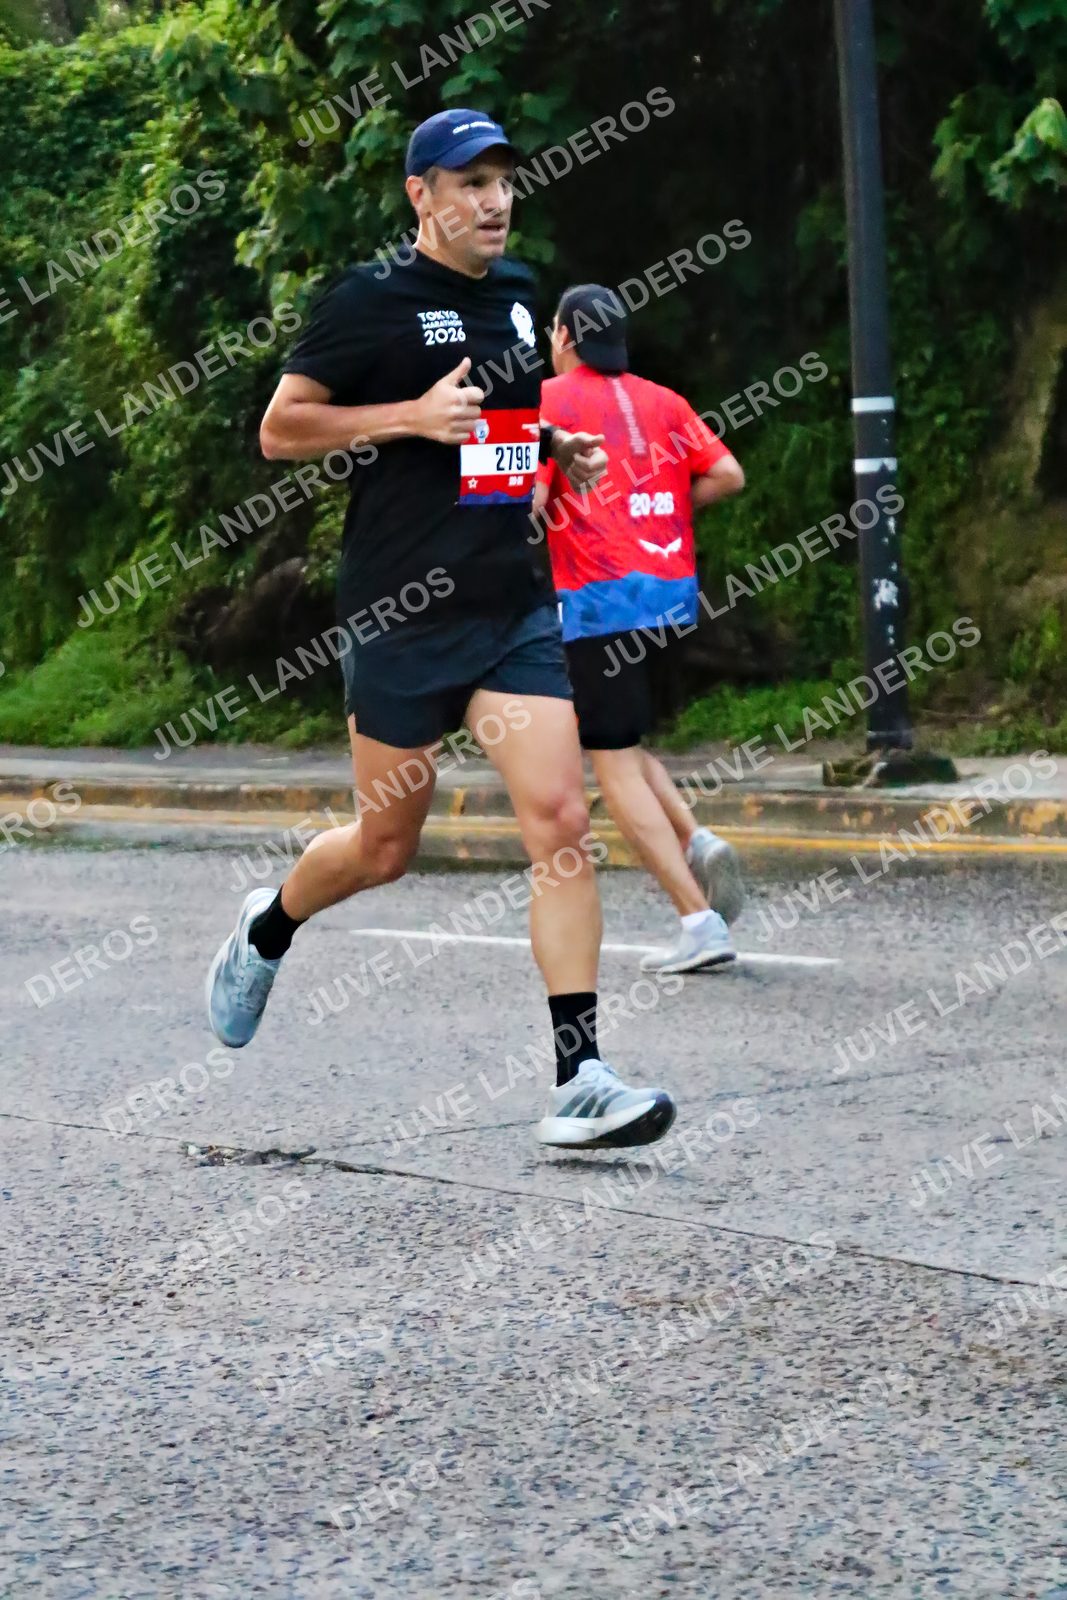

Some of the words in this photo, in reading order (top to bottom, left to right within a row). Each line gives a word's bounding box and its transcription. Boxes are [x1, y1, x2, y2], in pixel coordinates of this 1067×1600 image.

[417, 310, 459, 322] TOKYO
[422, 319, 463, 330] MARATHON
[424, 327, 466, 345] 2026
[495, 445, 531, 471] 2796
